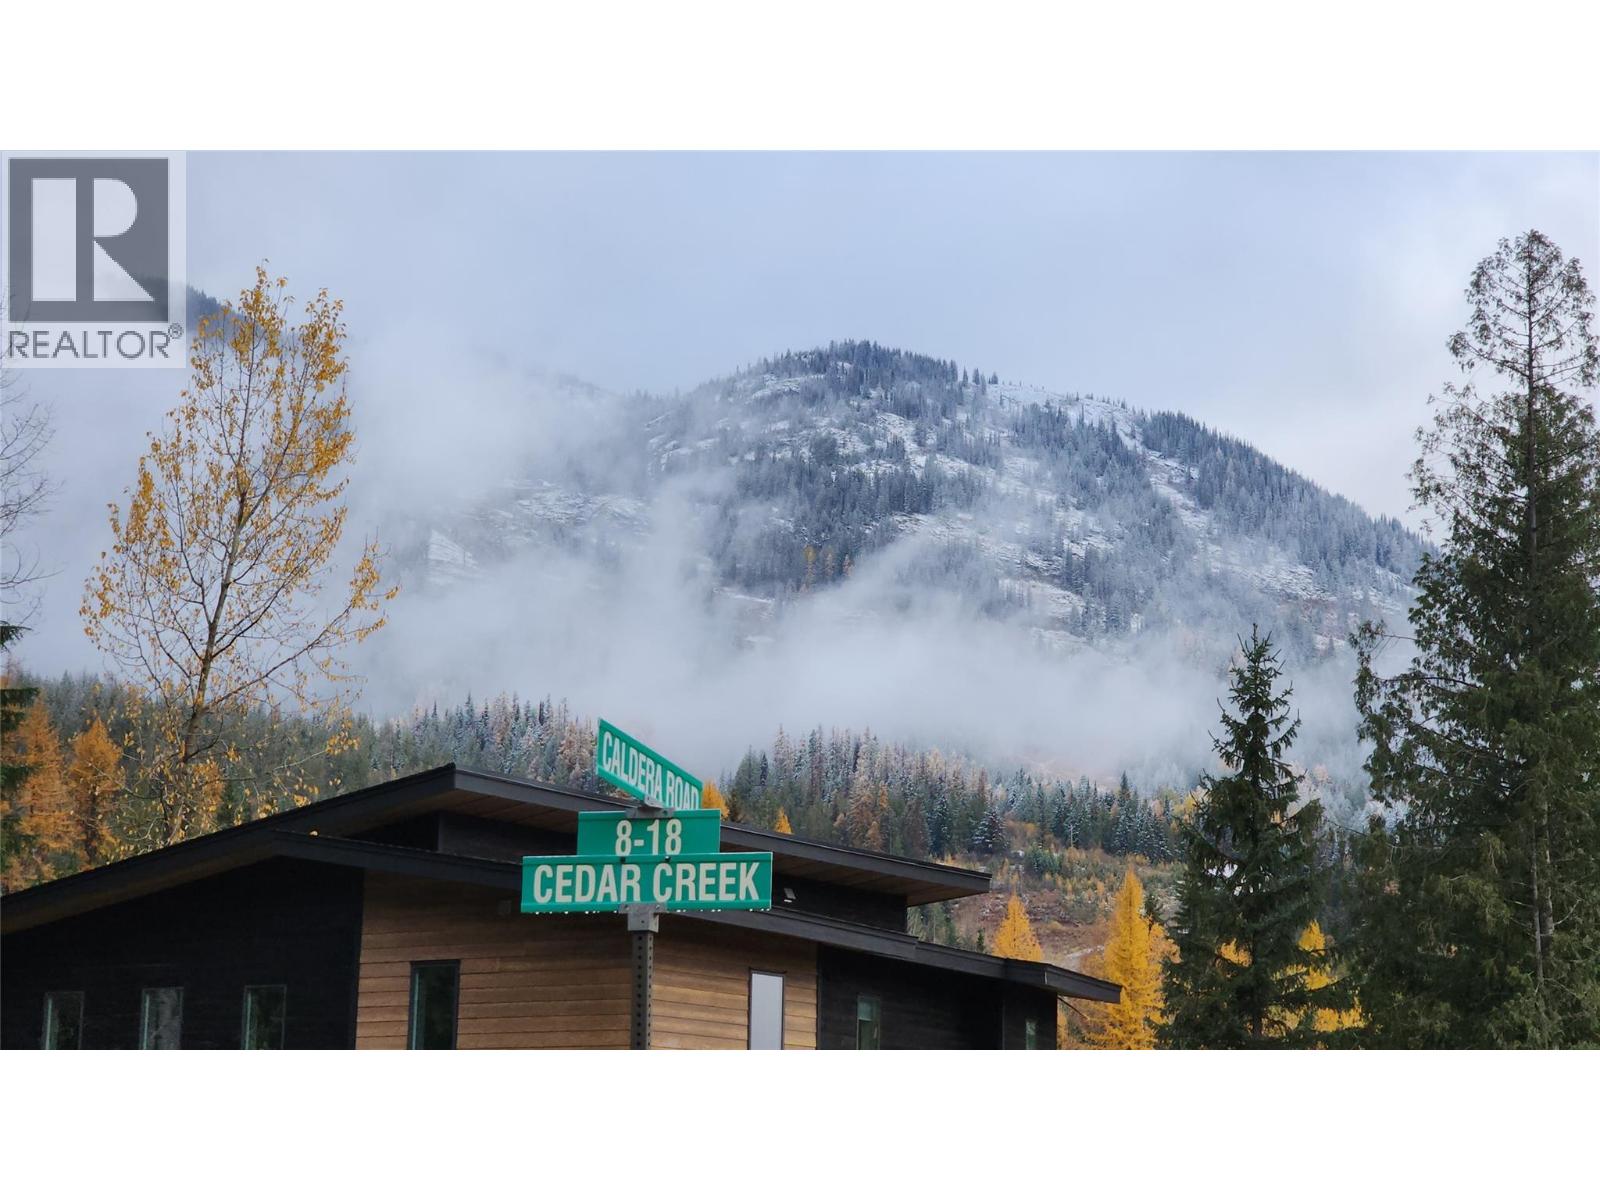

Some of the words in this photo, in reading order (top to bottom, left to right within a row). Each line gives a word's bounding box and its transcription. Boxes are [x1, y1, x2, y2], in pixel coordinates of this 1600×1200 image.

[602, 731, 663, 806] CALDERA
[665, 769, 700, 810] ROAD
[615, 818, 683, 856] 8-18
[533, 864, 641, 904] CEDAR
[652, 862, 760, 902] CREEK
